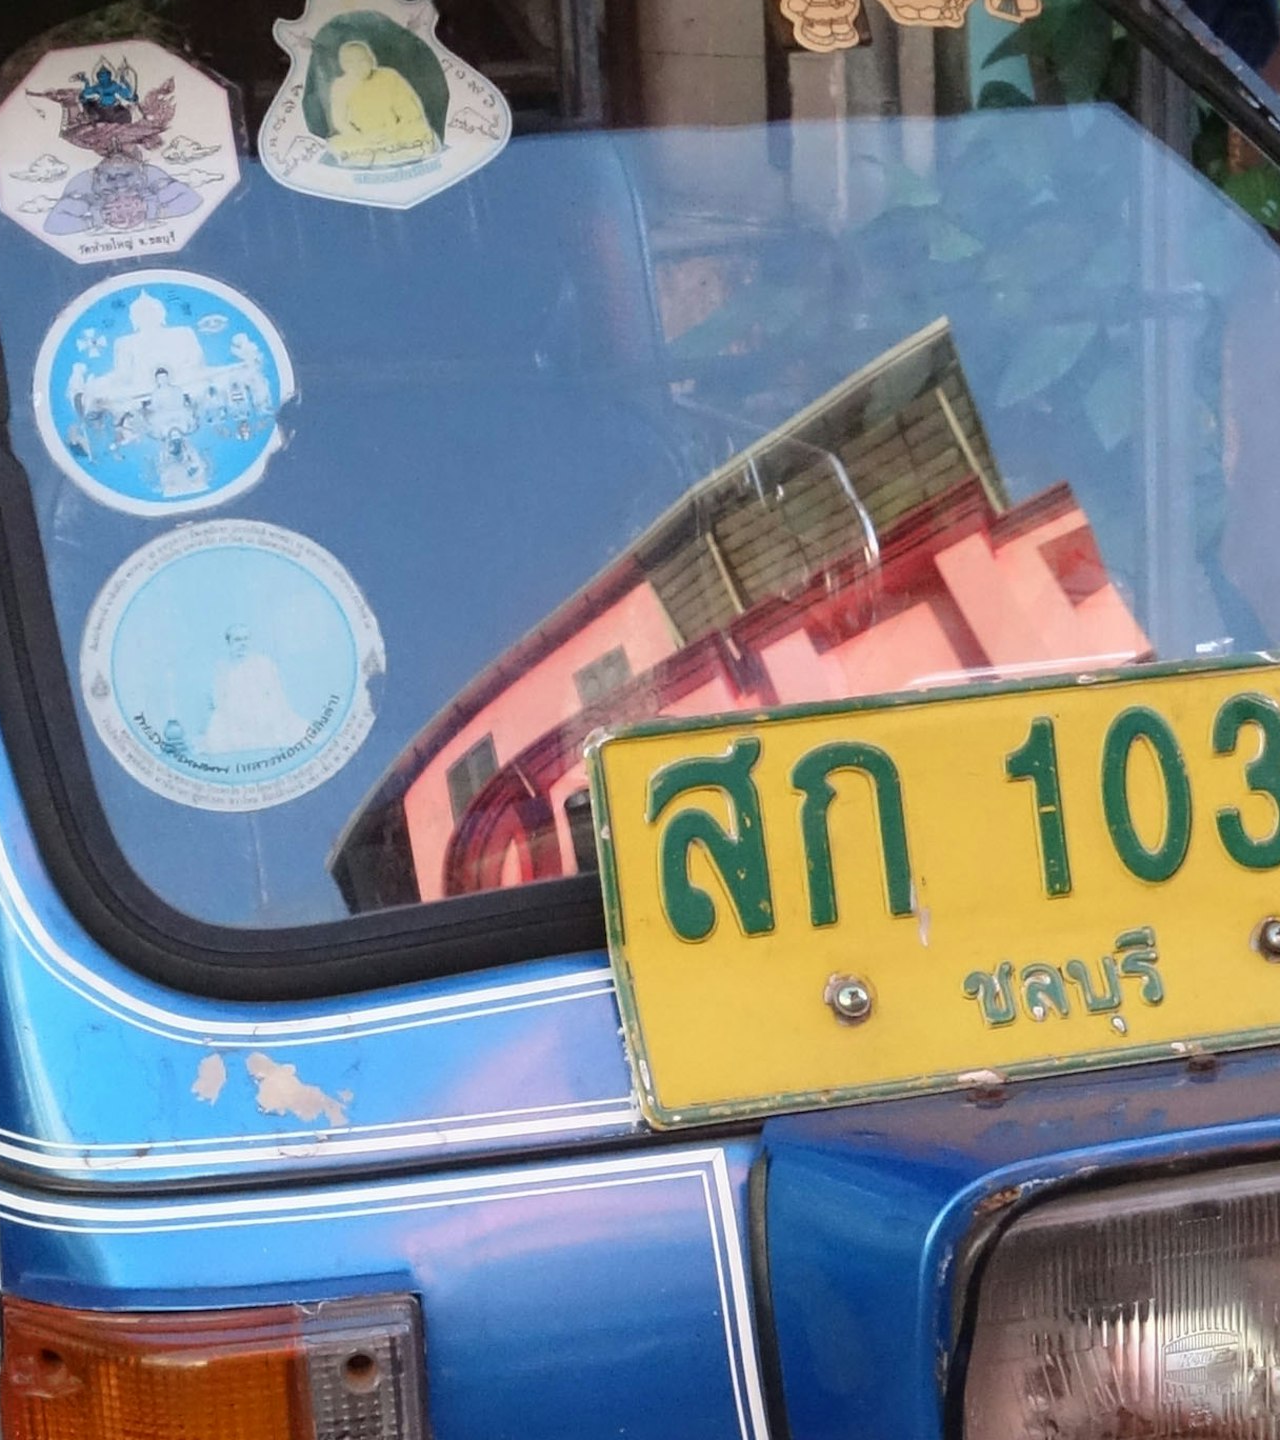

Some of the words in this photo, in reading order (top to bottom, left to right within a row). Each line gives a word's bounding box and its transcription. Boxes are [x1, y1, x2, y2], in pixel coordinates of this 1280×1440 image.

[645, 736, 916, 944] สก
[963, 925, 1166, 1035] ชลบุรี
